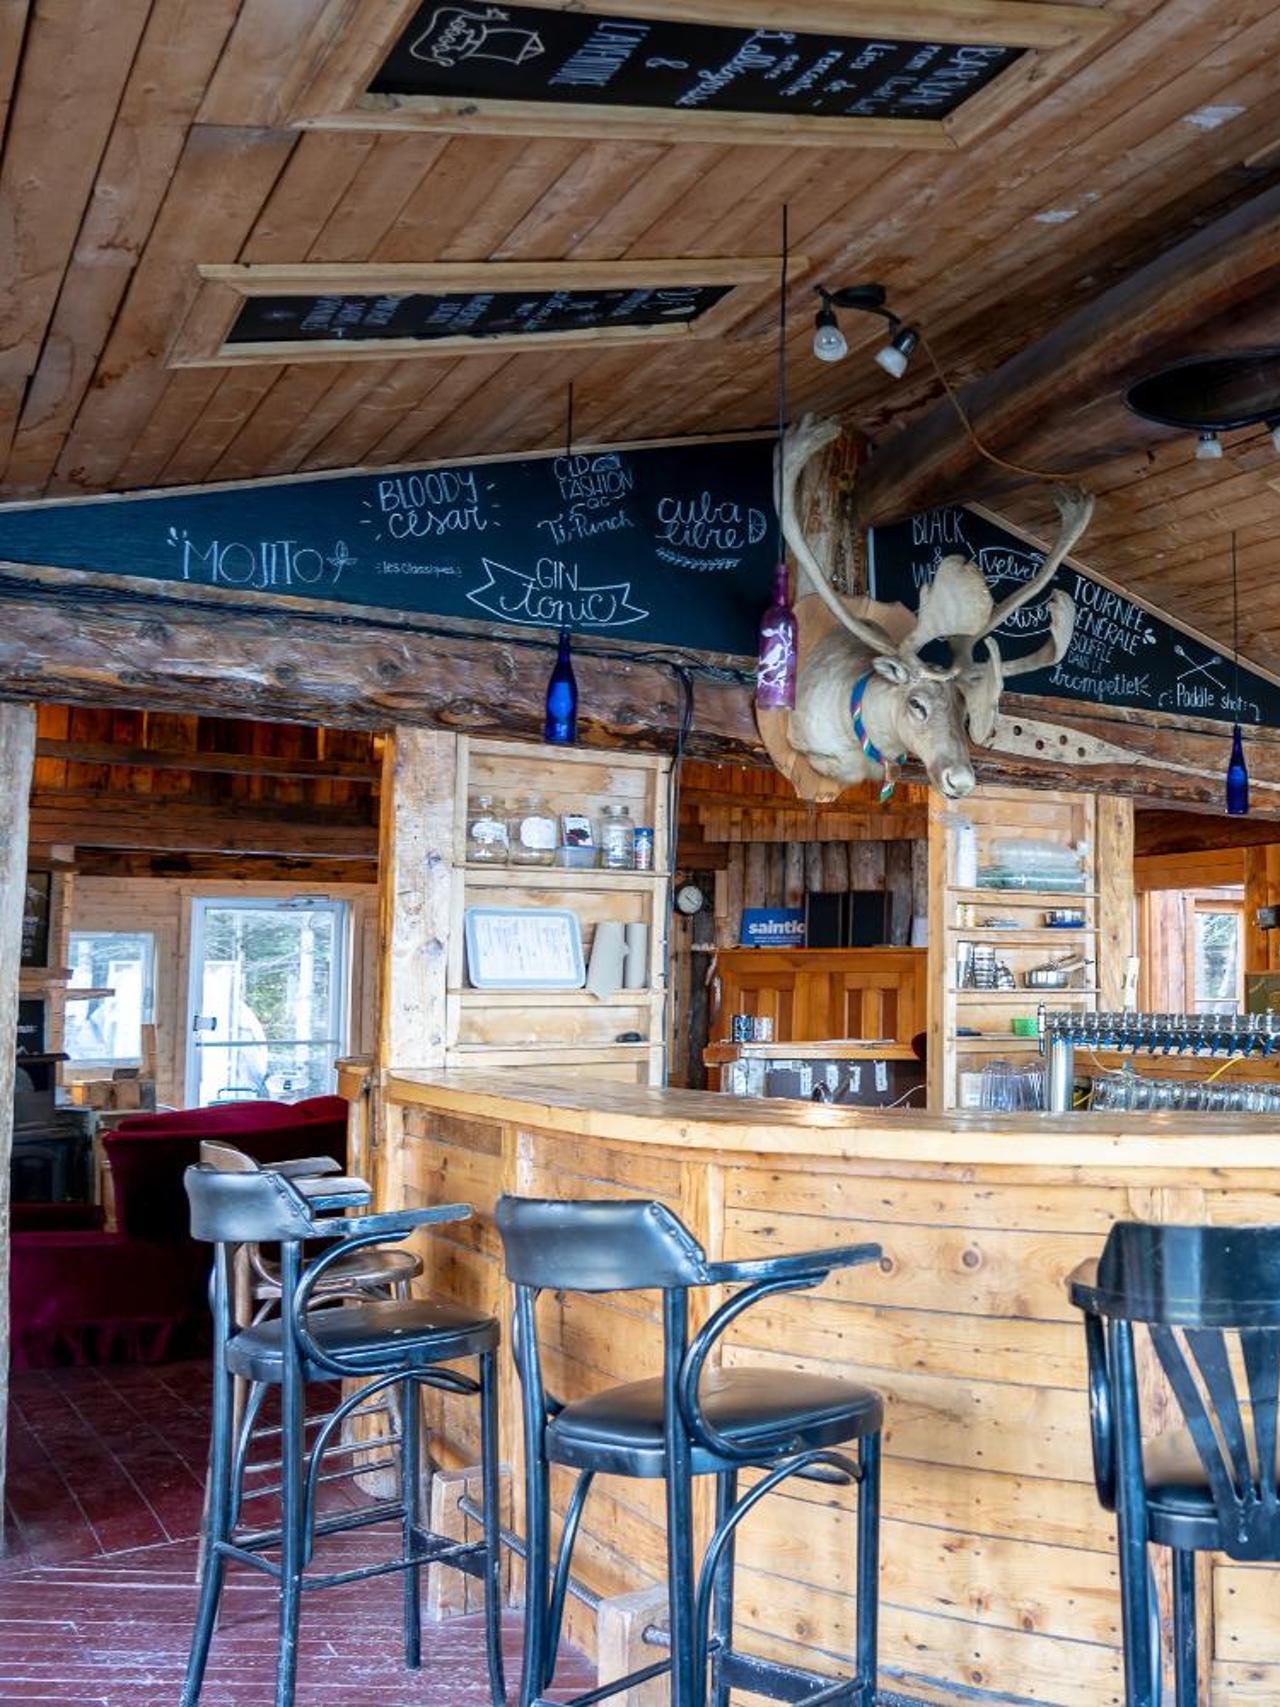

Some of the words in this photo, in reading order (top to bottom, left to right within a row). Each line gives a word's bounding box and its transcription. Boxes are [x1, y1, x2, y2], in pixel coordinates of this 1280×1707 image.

[379, 471, 478, 512] BLOODY
[912, 511, 965, 545] BLACK
[182, 540, 324, 588] MOJITO
[536, 558, 579, 591] GIN
